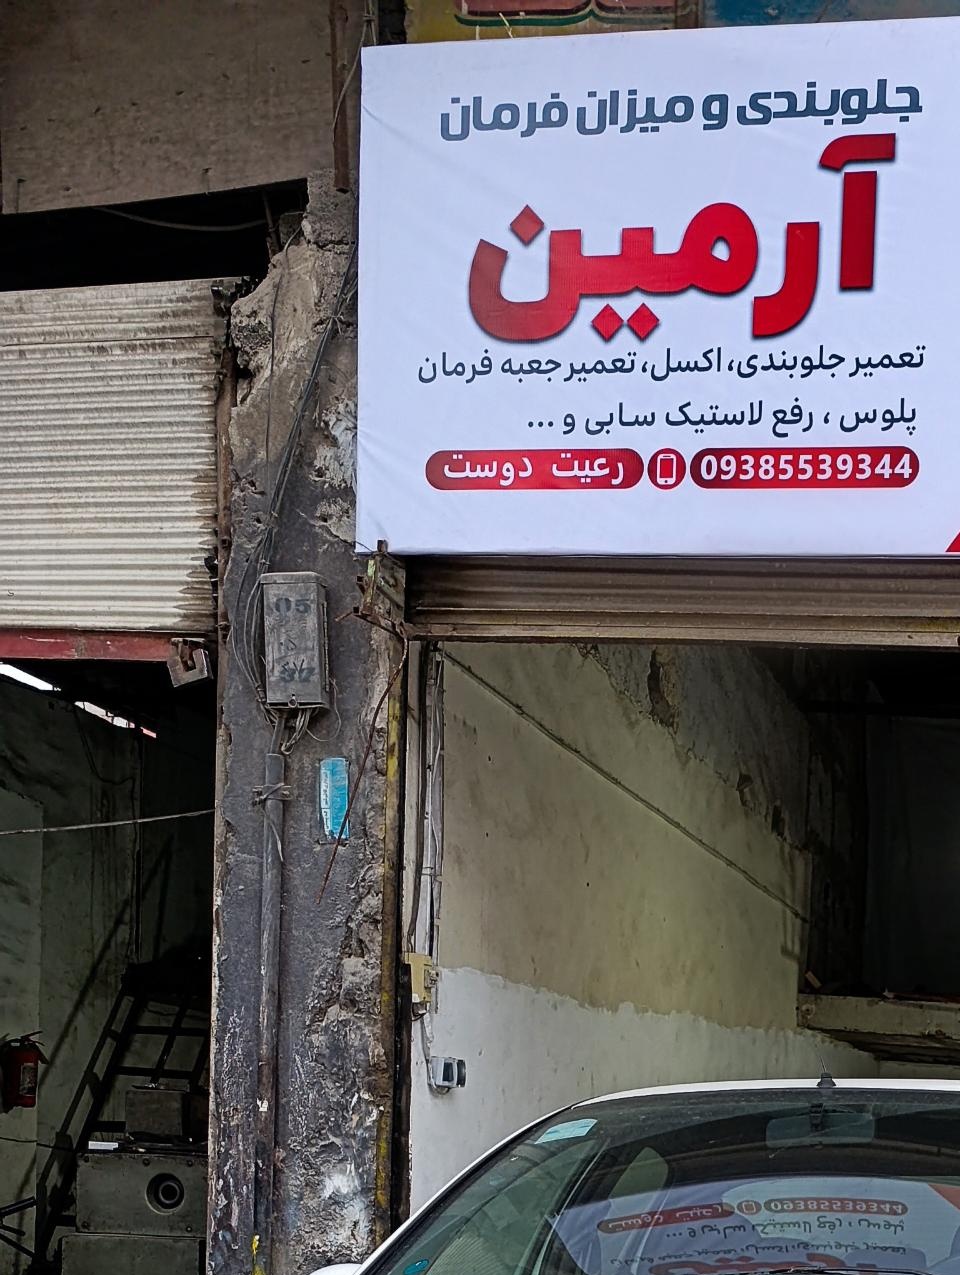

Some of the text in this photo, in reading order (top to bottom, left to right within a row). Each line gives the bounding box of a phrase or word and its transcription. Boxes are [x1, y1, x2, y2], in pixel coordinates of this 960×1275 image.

[440, 78, 923, 142] جلوبندی و میزان فرمان
[468, 132, 897, 345] آرمین
[418, 348, 493, 384] فرمان
[500, 357, 562, 384] جعبه
[563, 351, 637, 383] تعمیر
[848, 344, 927, 378] تعمیر
[562, 413, 576, 435] و
[584, 402, 656, 436] سابی
[665, 399, 763, 434] لاستیک
[771, 396, 814, 439] رفع
[839, 397, 917, 437] پلوس
[443, 453, 624, 487] رعیت دوست
[700, 453, 913, 480] 09385539344
